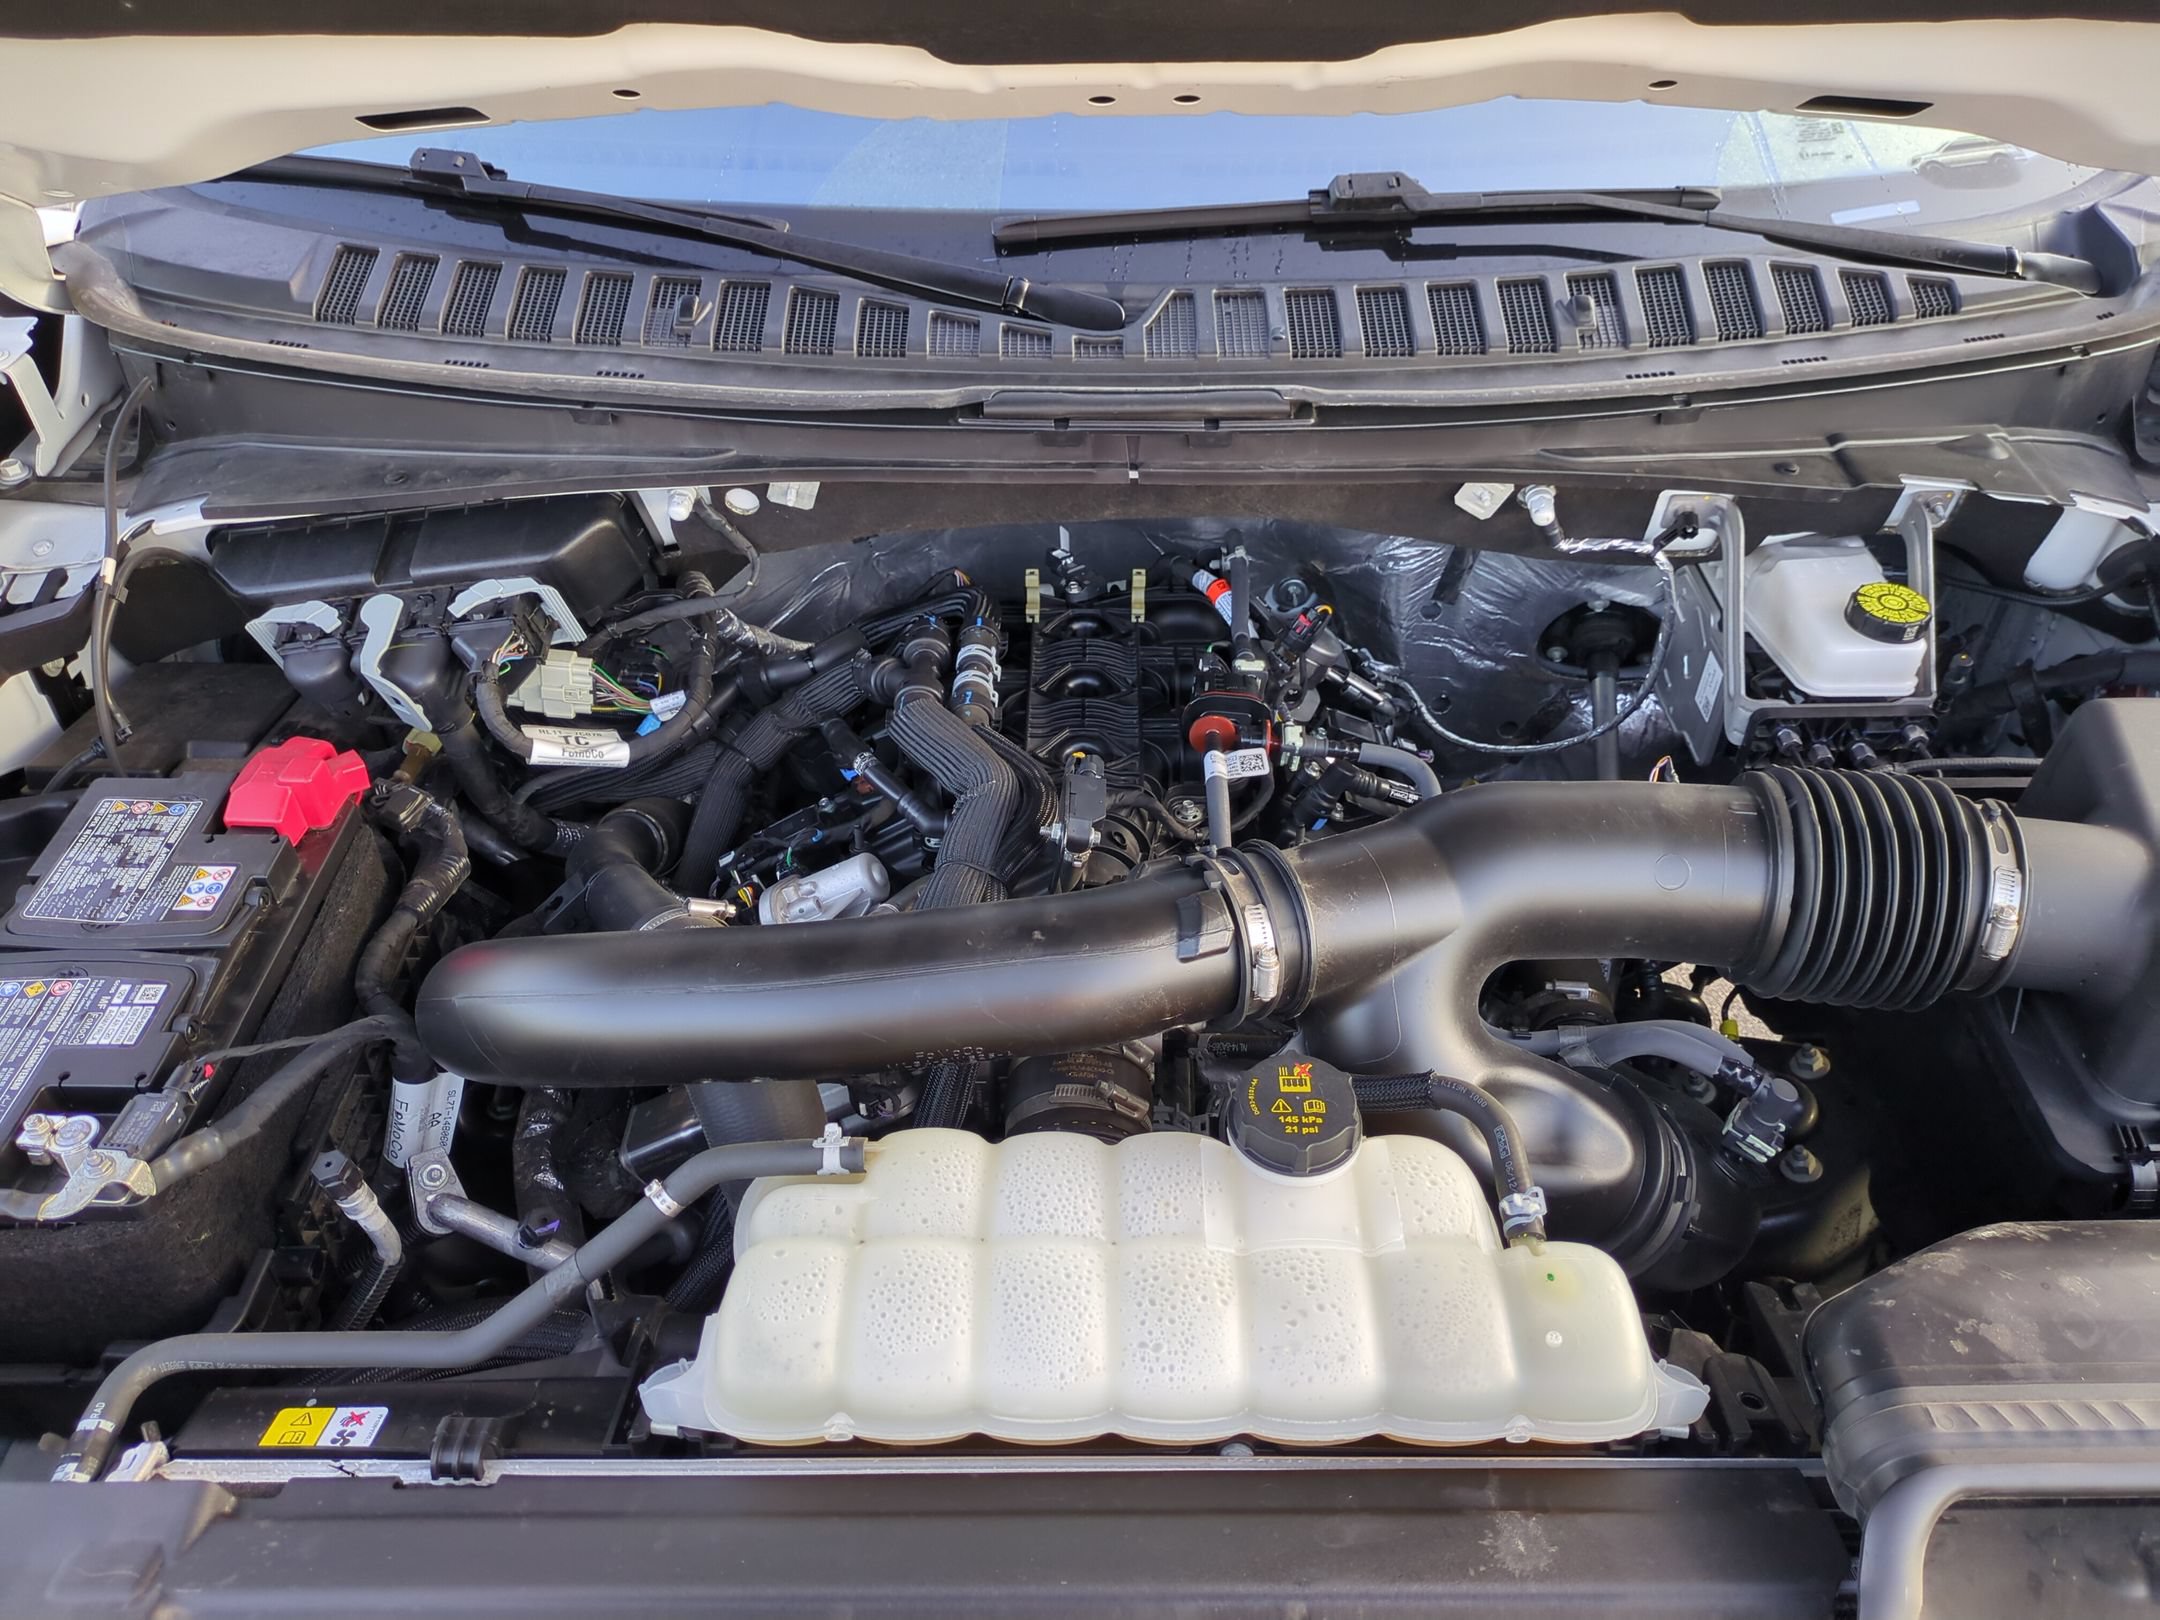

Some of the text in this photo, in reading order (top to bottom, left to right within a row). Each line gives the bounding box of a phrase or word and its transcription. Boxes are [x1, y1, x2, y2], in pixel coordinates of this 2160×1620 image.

[561, 735, 590, 746] TC
[1278, 1115, 1324, 1124] 145 kPa
[1284, 1125, 1319, 1135] 21 psi
[89, 1402, 106, 1419] RAD
